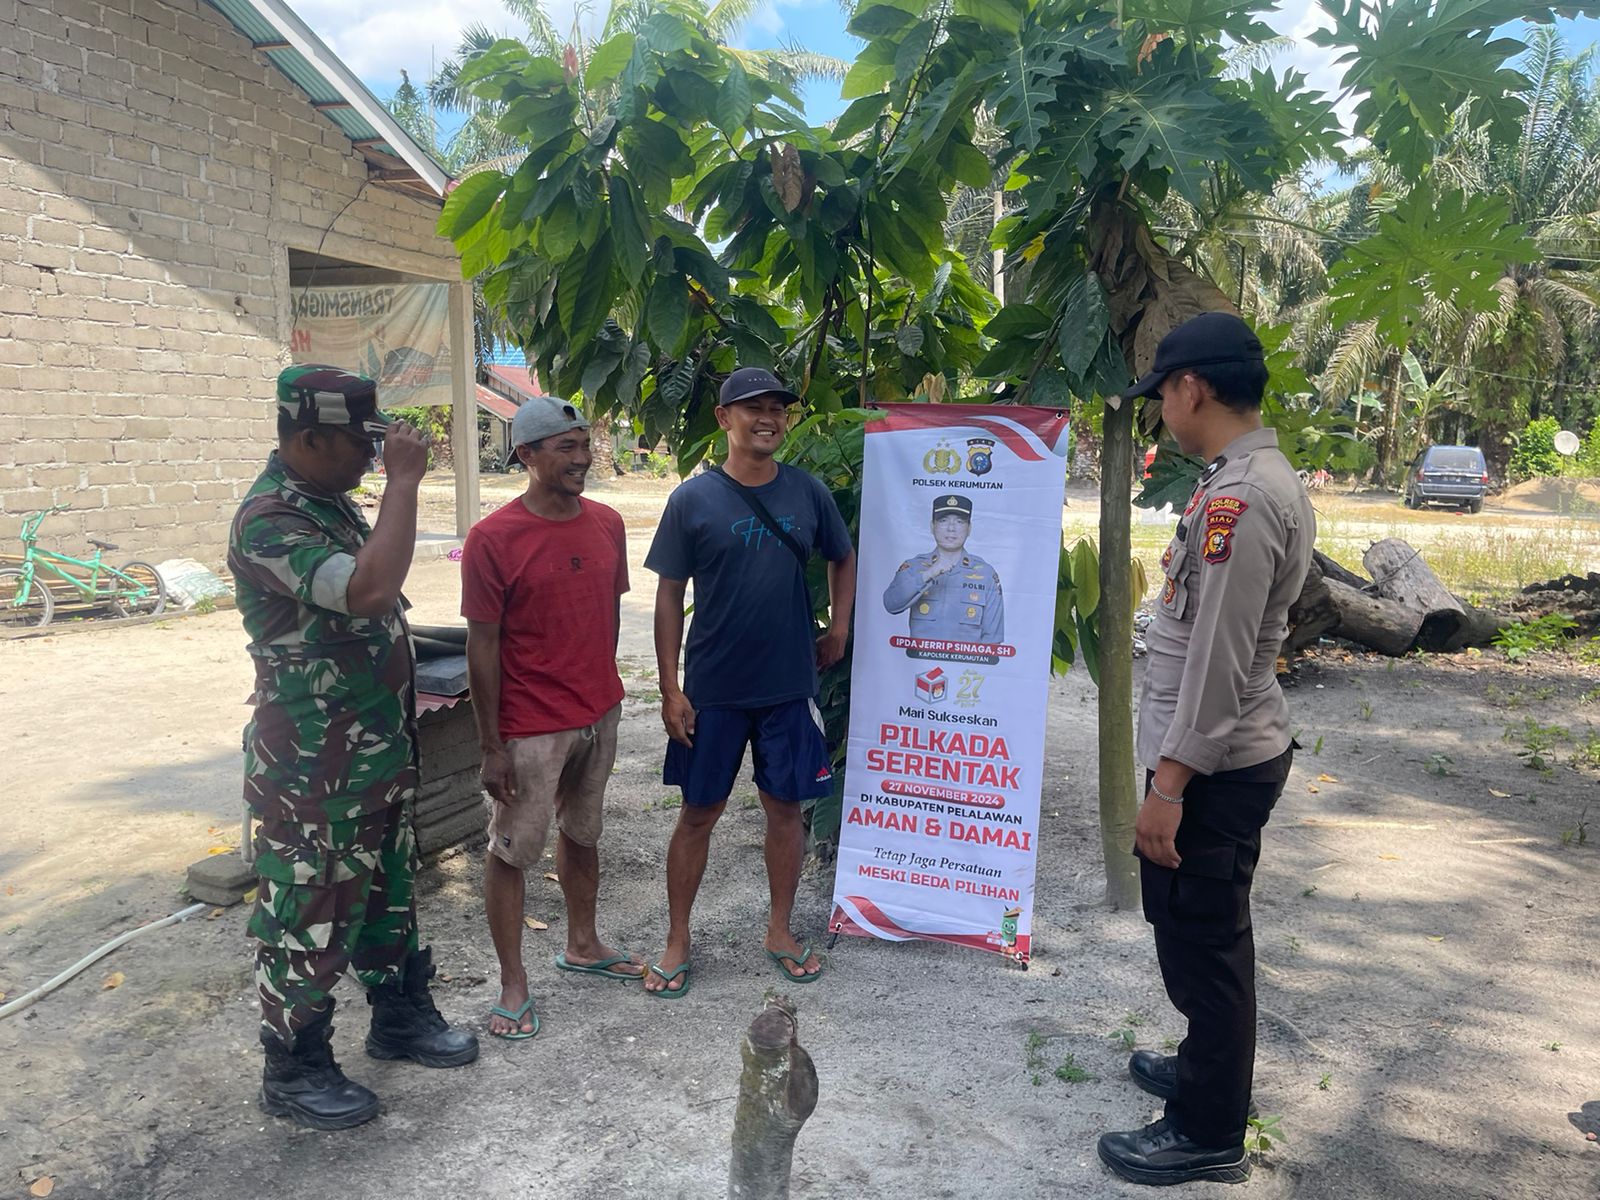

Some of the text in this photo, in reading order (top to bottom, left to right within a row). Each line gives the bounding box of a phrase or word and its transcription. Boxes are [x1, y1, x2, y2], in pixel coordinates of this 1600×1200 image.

[912, 478, 1003, 490] POLSEK KERUMUTAN
[1209, 516, 1233, 524] RIAU
[962, 582, 985, 591] POLRI
[896, 638, 1011, 656] IPDA JERRI P SINAGA, SH
[918, 651, 989, 663] KAPOLSEK KERUMUTAN
[956, 674, 985, 699] 27
[899, 705, 998, 727] Mari Sukseskan
[880, 723, 1009, 761] PILKADA
[866, 749, 1020, 790] SERENTAK
[888, 781, 1000, 806] 27 NOVEMBER 2024
[860, 793, 1022, 825] DI KABUPATEN PELALAWAN
[847, 807, 1032, 851] AMAN & DAMAI
[873, 846, 1002, 879] Tetap Jaga Persatuan
[858, 865, 1020, 902] MESKI BEDA PILIHAN
